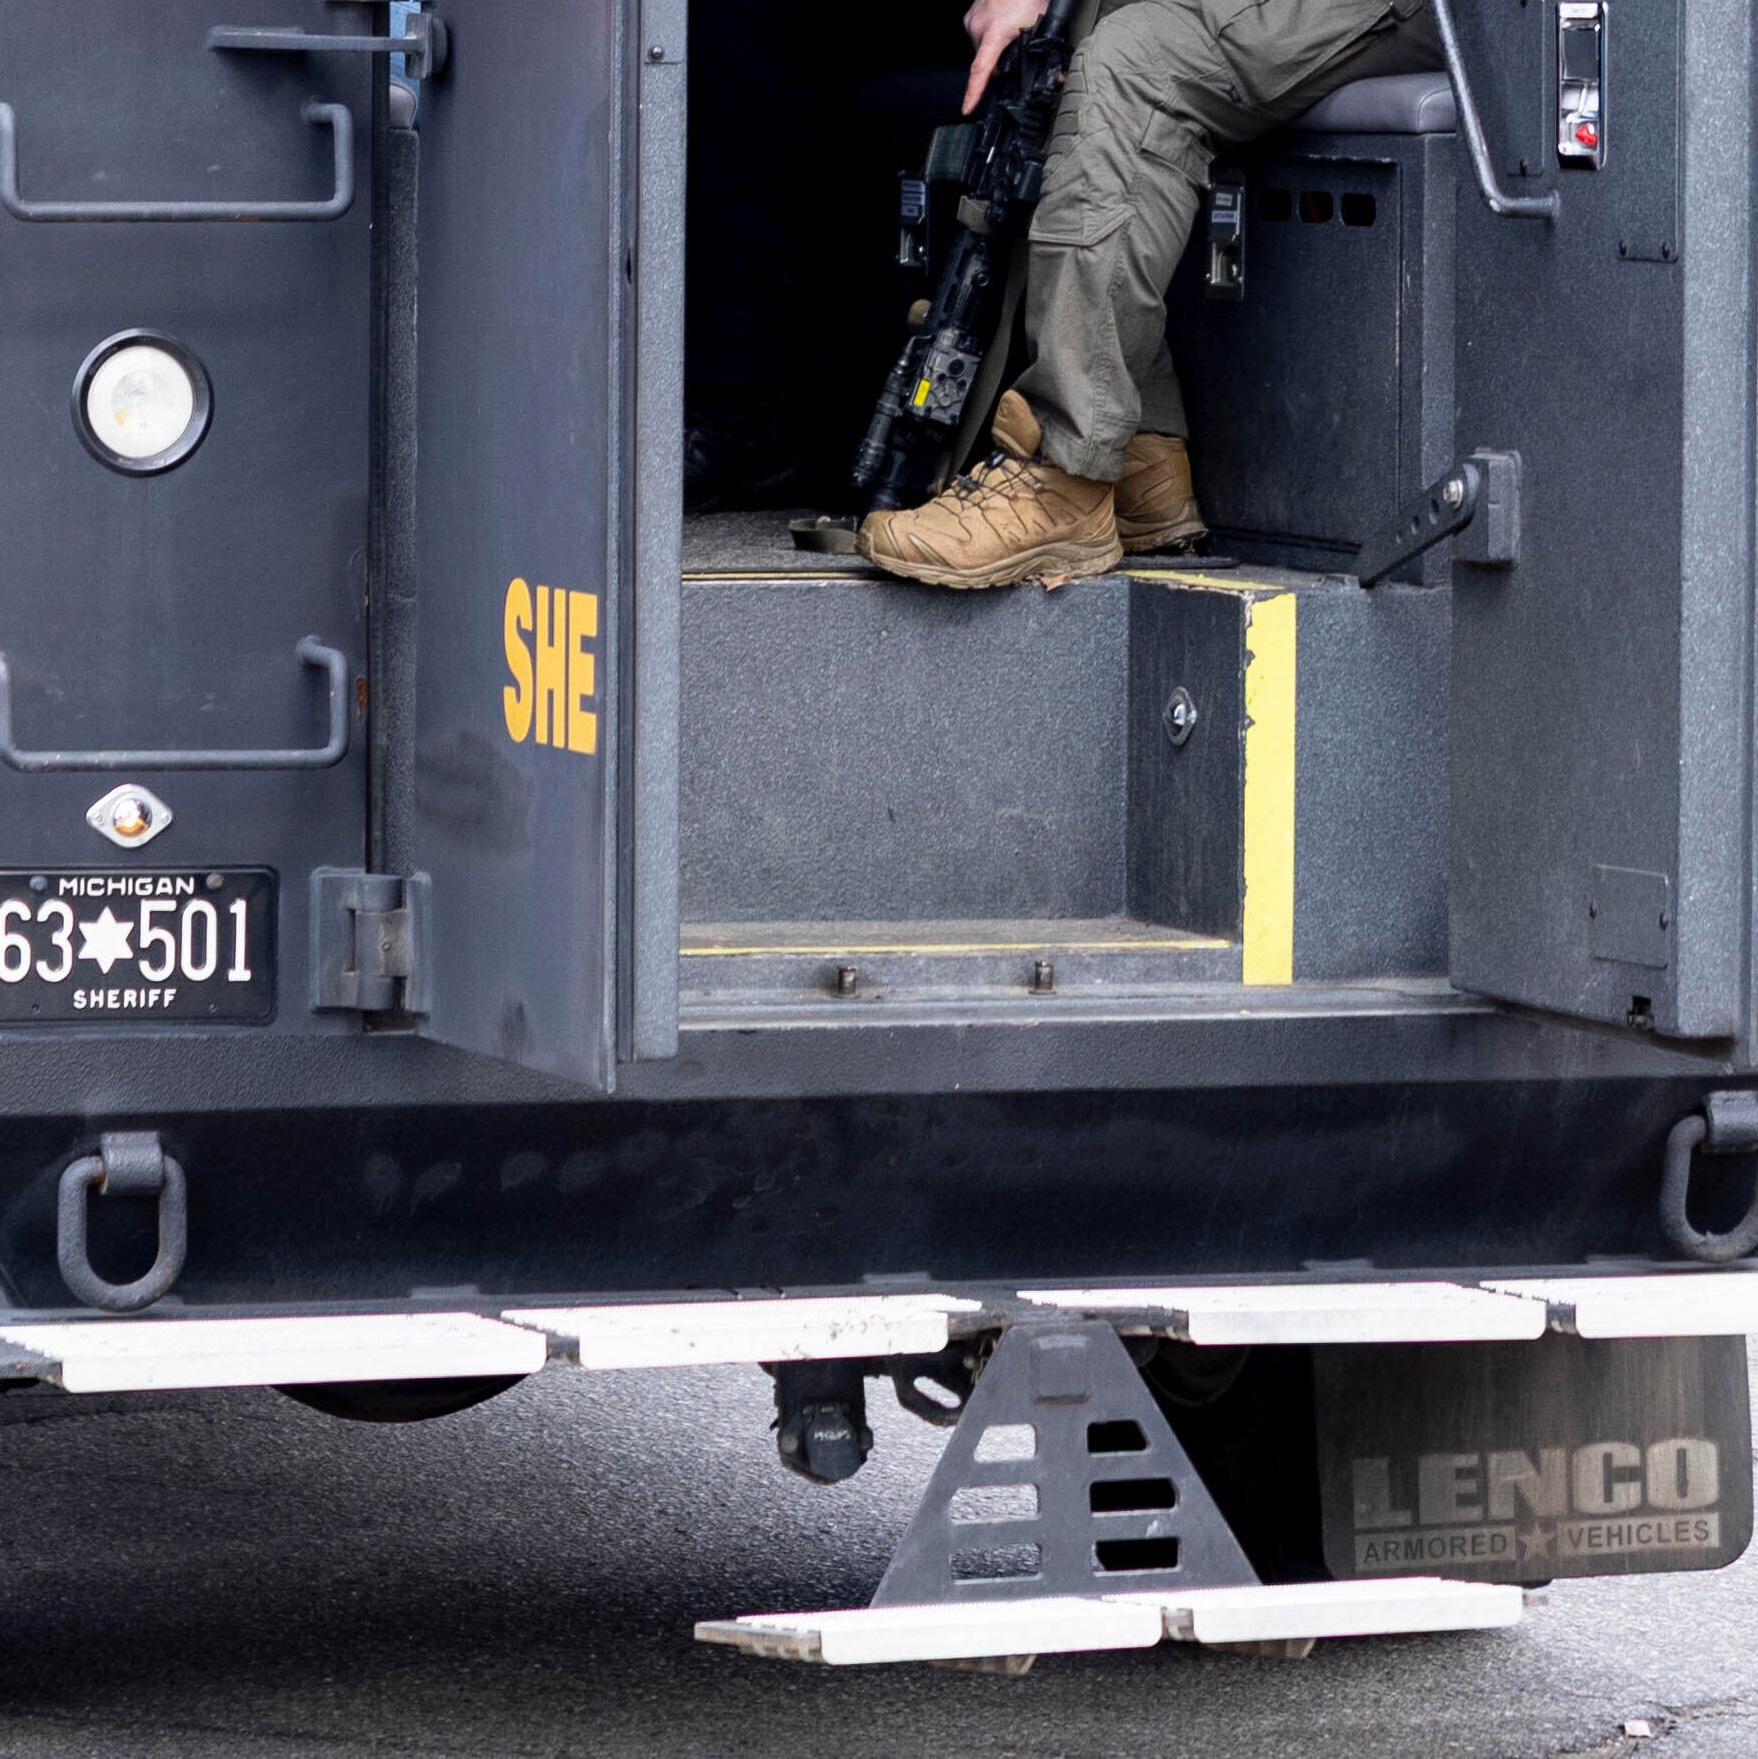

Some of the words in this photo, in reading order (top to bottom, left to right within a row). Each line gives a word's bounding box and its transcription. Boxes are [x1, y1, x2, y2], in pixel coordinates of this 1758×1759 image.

[503, 577, 598, 755] SHE
[58, 876, 195, 898] MICHIGAN
[138, 897, 252, 983] 501
[73, 988, 178, 1010] SHERIFF
[1352, 1438, 1720, 1529] LENCO
[1363, 1532, 1508, 1564] ARMORED
[1566, 1519, 1710, 1551] VEHICLES
